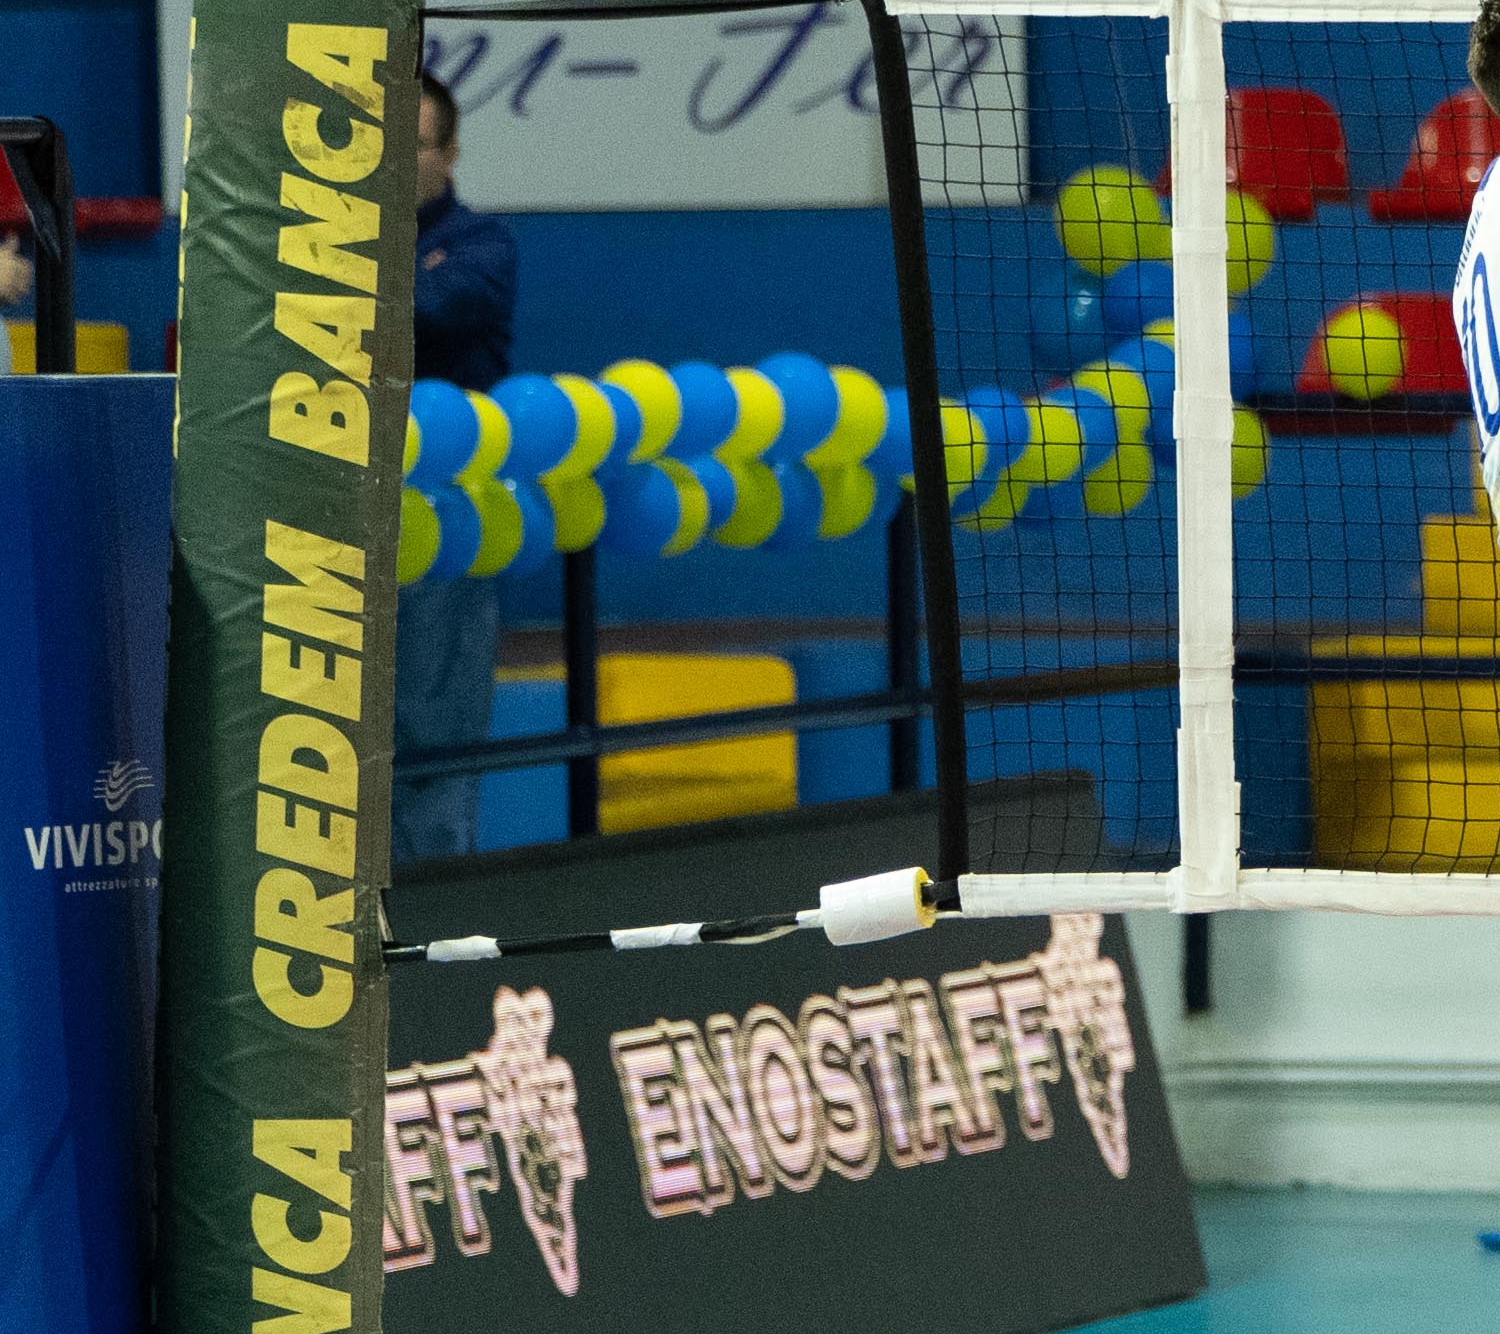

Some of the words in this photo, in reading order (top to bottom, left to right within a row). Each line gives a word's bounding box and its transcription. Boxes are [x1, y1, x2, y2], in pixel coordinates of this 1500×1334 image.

[268, 22, 389, 467] BANCA
[252, 519, 366, 1031] CREDEM
[611, 955, 1061, 1218] ENOSTAFF
